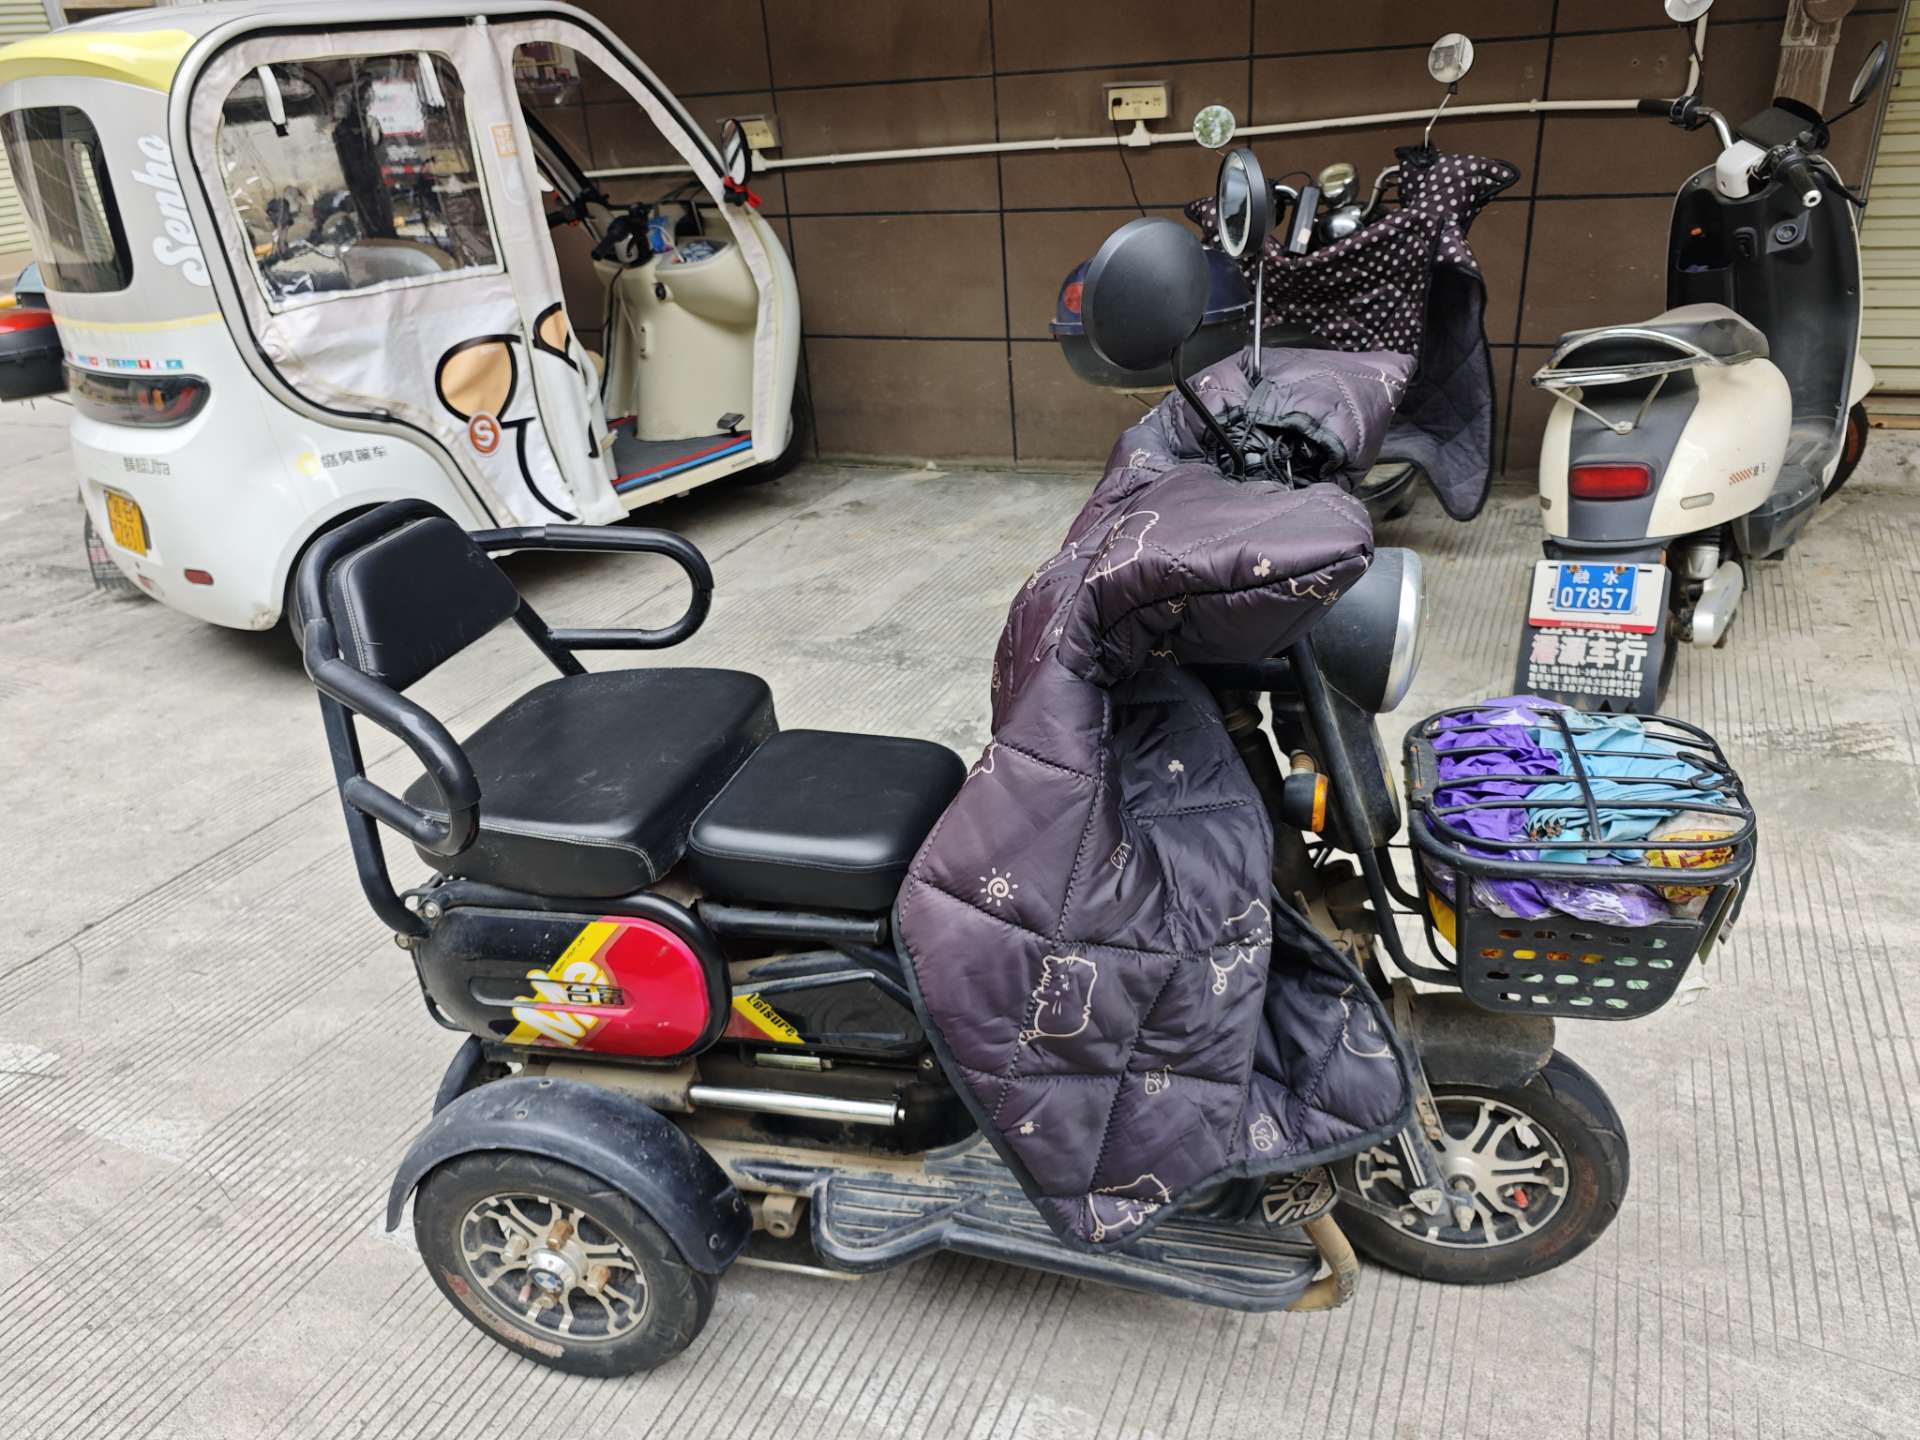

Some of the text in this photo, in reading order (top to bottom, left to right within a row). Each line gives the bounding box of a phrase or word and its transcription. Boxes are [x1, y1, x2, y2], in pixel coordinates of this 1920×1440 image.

[131, 134, 212, 287] Senho
[473, 419, 496, 448] S
[1560, 586, 1629, 609] 07857
[745, 992, 797, 1037] Leisure
